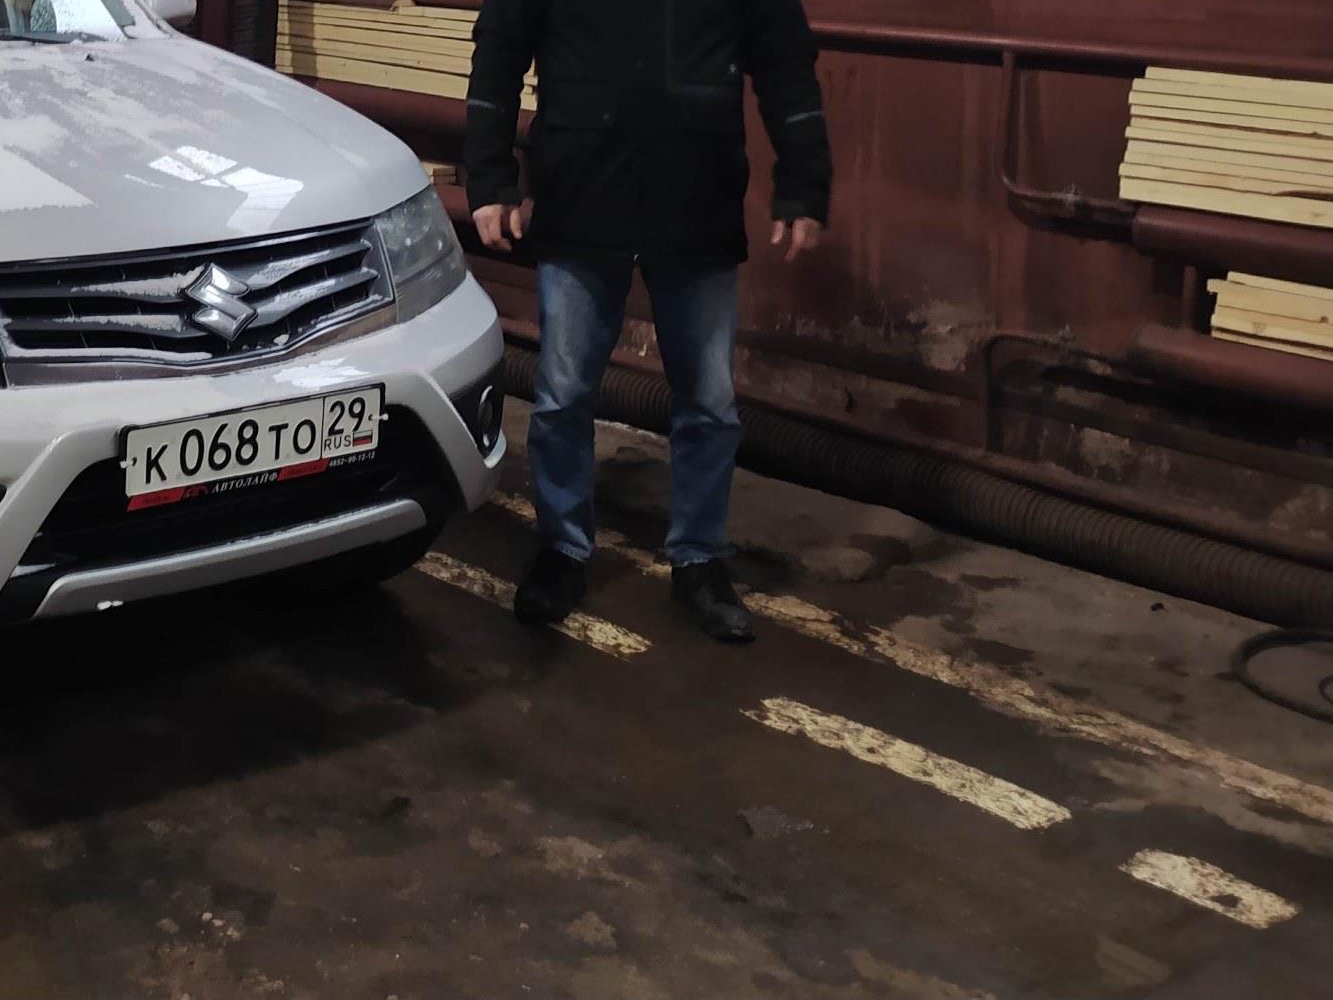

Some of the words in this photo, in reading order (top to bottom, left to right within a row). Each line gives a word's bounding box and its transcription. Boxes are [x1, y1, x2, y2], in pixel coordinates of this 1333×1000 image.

[327, 397, 367, 437] 29
[324, 435, 352, 451] RUS
[211, 471, 278, 494] АВТОЛАЙФ
